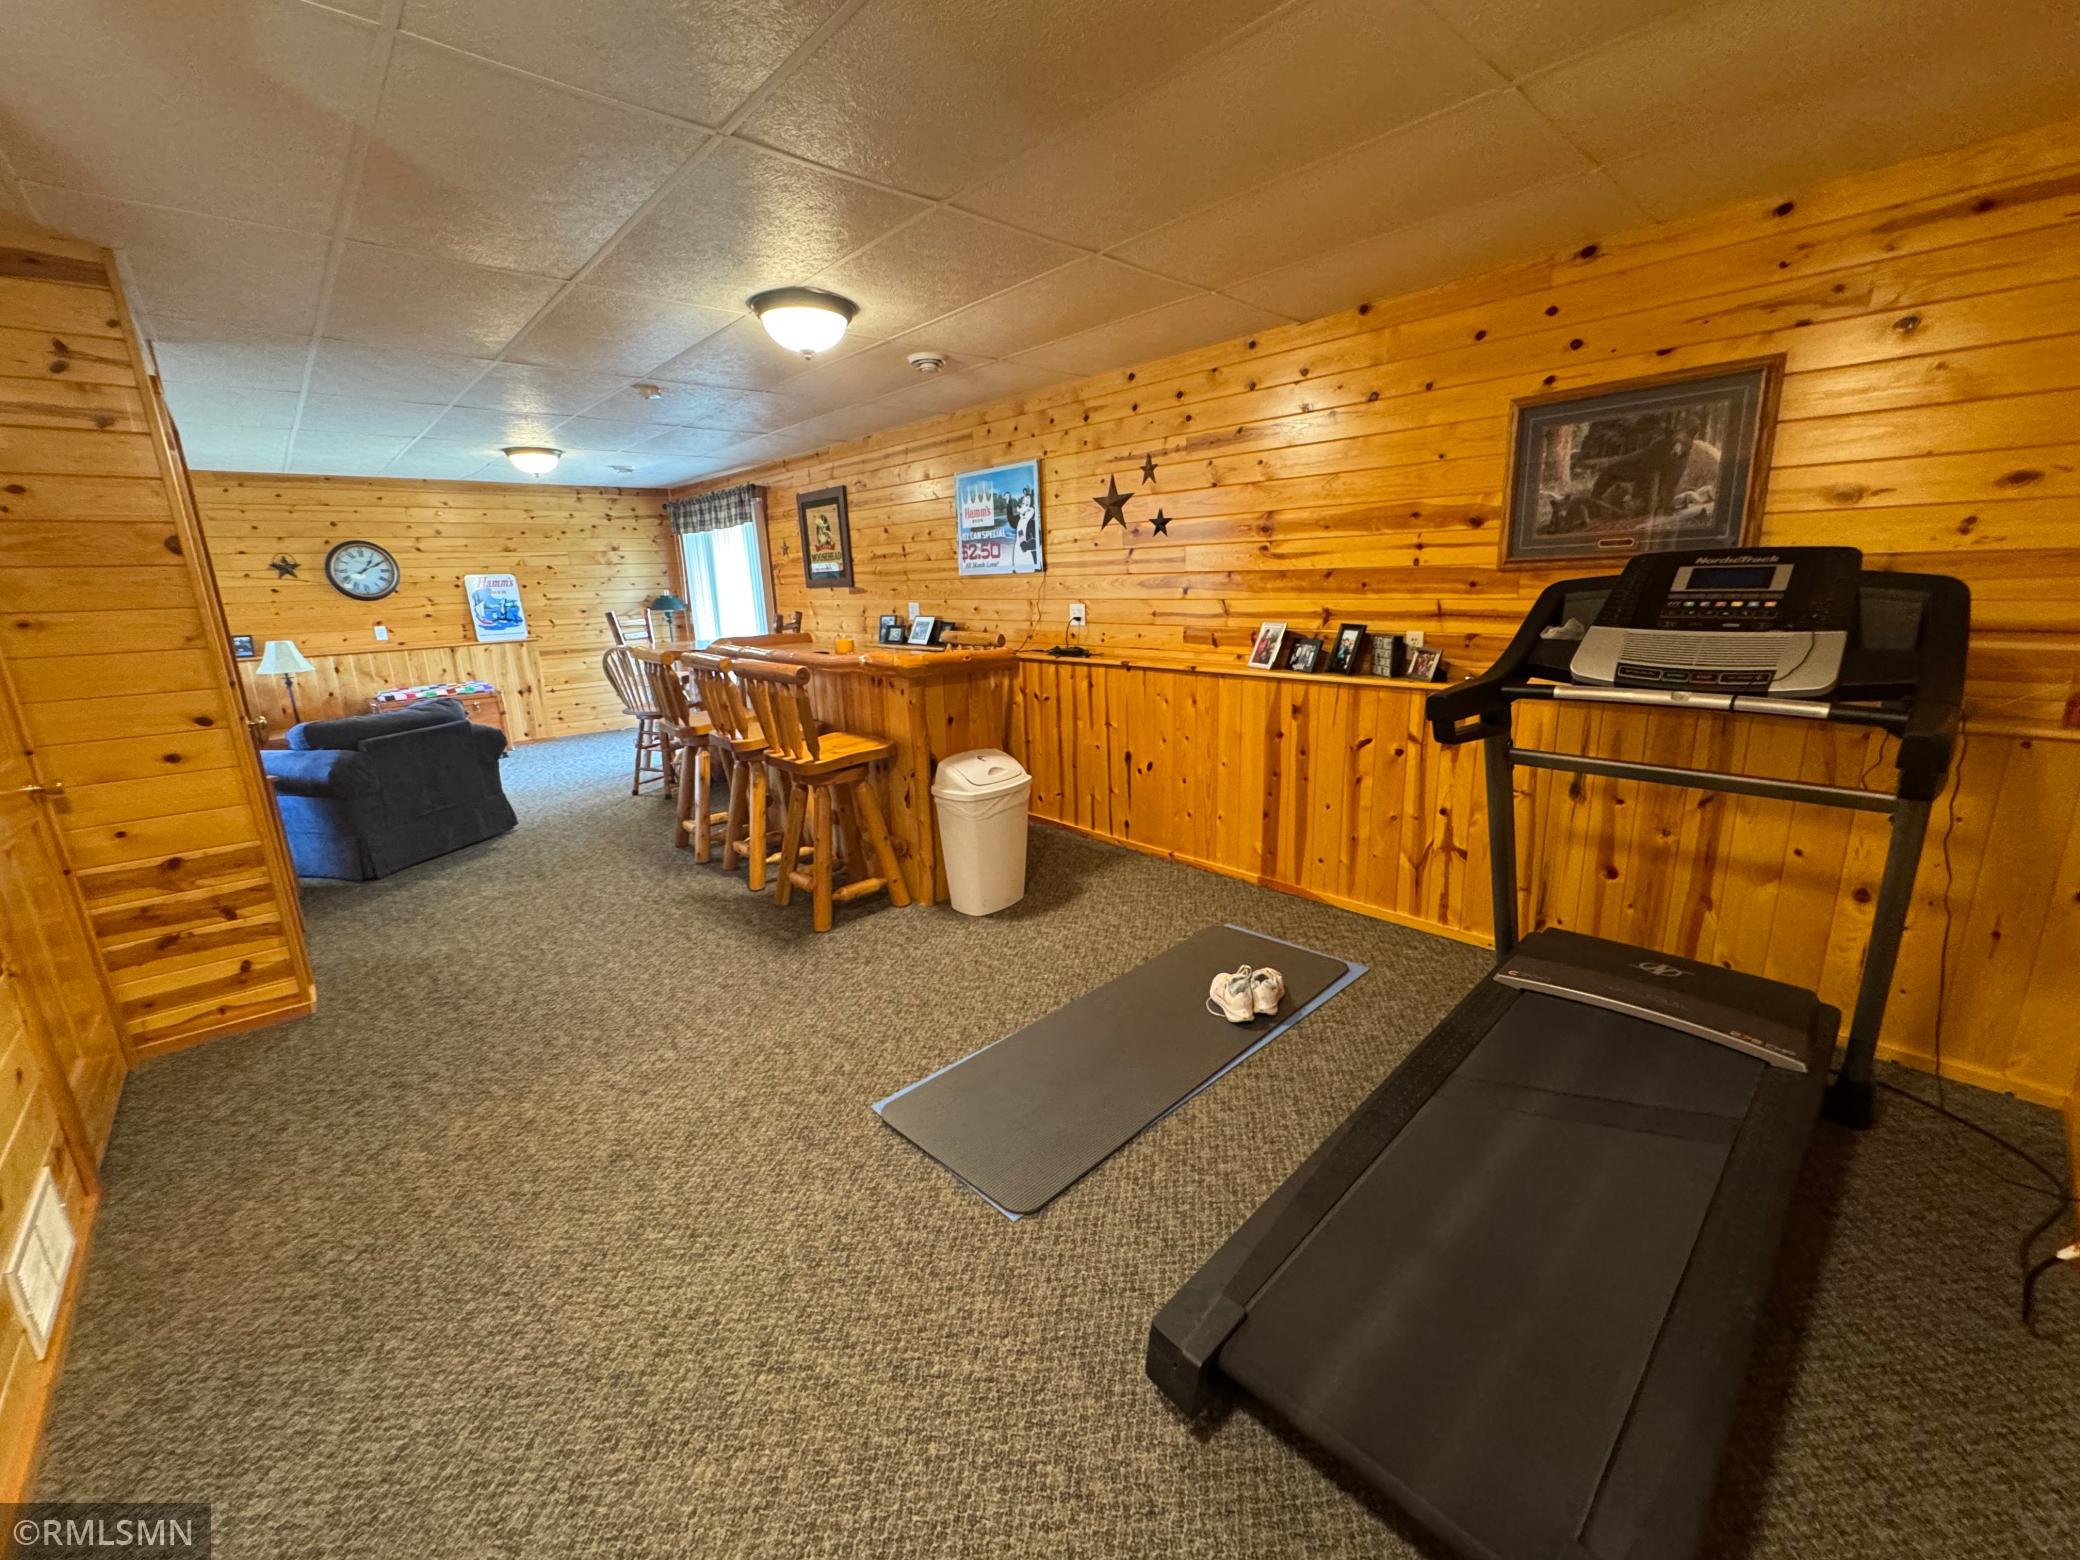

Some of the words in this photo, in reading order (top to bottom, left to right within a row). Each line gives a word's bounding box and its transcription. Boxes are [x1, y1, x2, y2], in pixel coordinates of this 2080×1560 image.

[965, 506, 991, 519] Hamm's
[962, 541, 1001, 562] $2.50
[1695, 555, 1780, 565] NordicTrack
[478, 576, 514, 588] Hamm's
